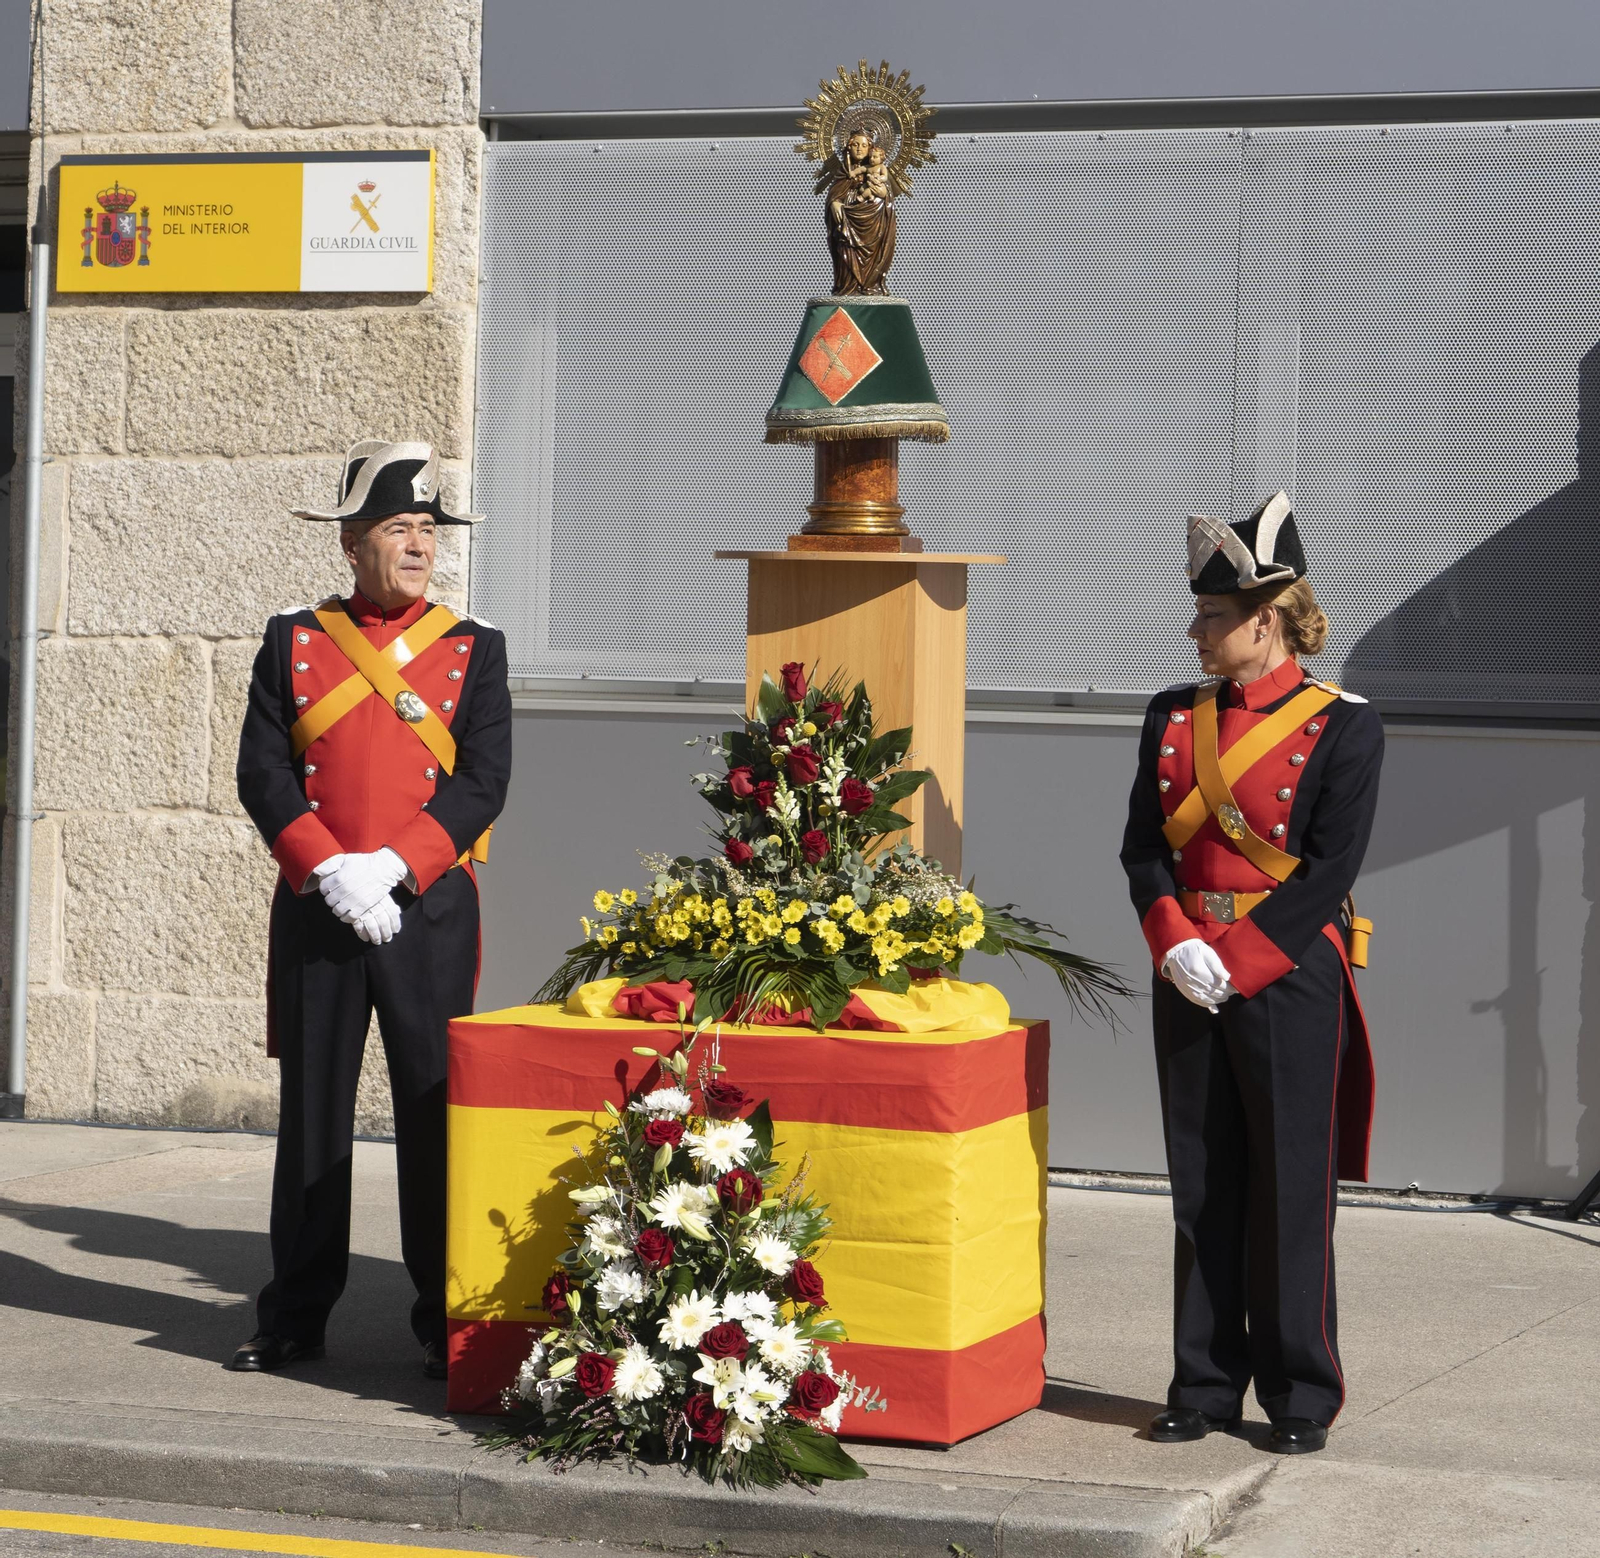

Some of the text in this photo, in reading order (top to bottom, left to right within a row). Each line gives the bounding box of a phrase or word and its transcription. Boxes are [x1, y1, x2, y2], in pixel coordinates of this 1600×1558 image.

[163, 204, 234, 216] MINISTERIO
[162, 223, 185, 235] DEL
[190, 222, 250, 235] INTERIOR
[309, 236, 418, 249] GUARDIA CIVIL
